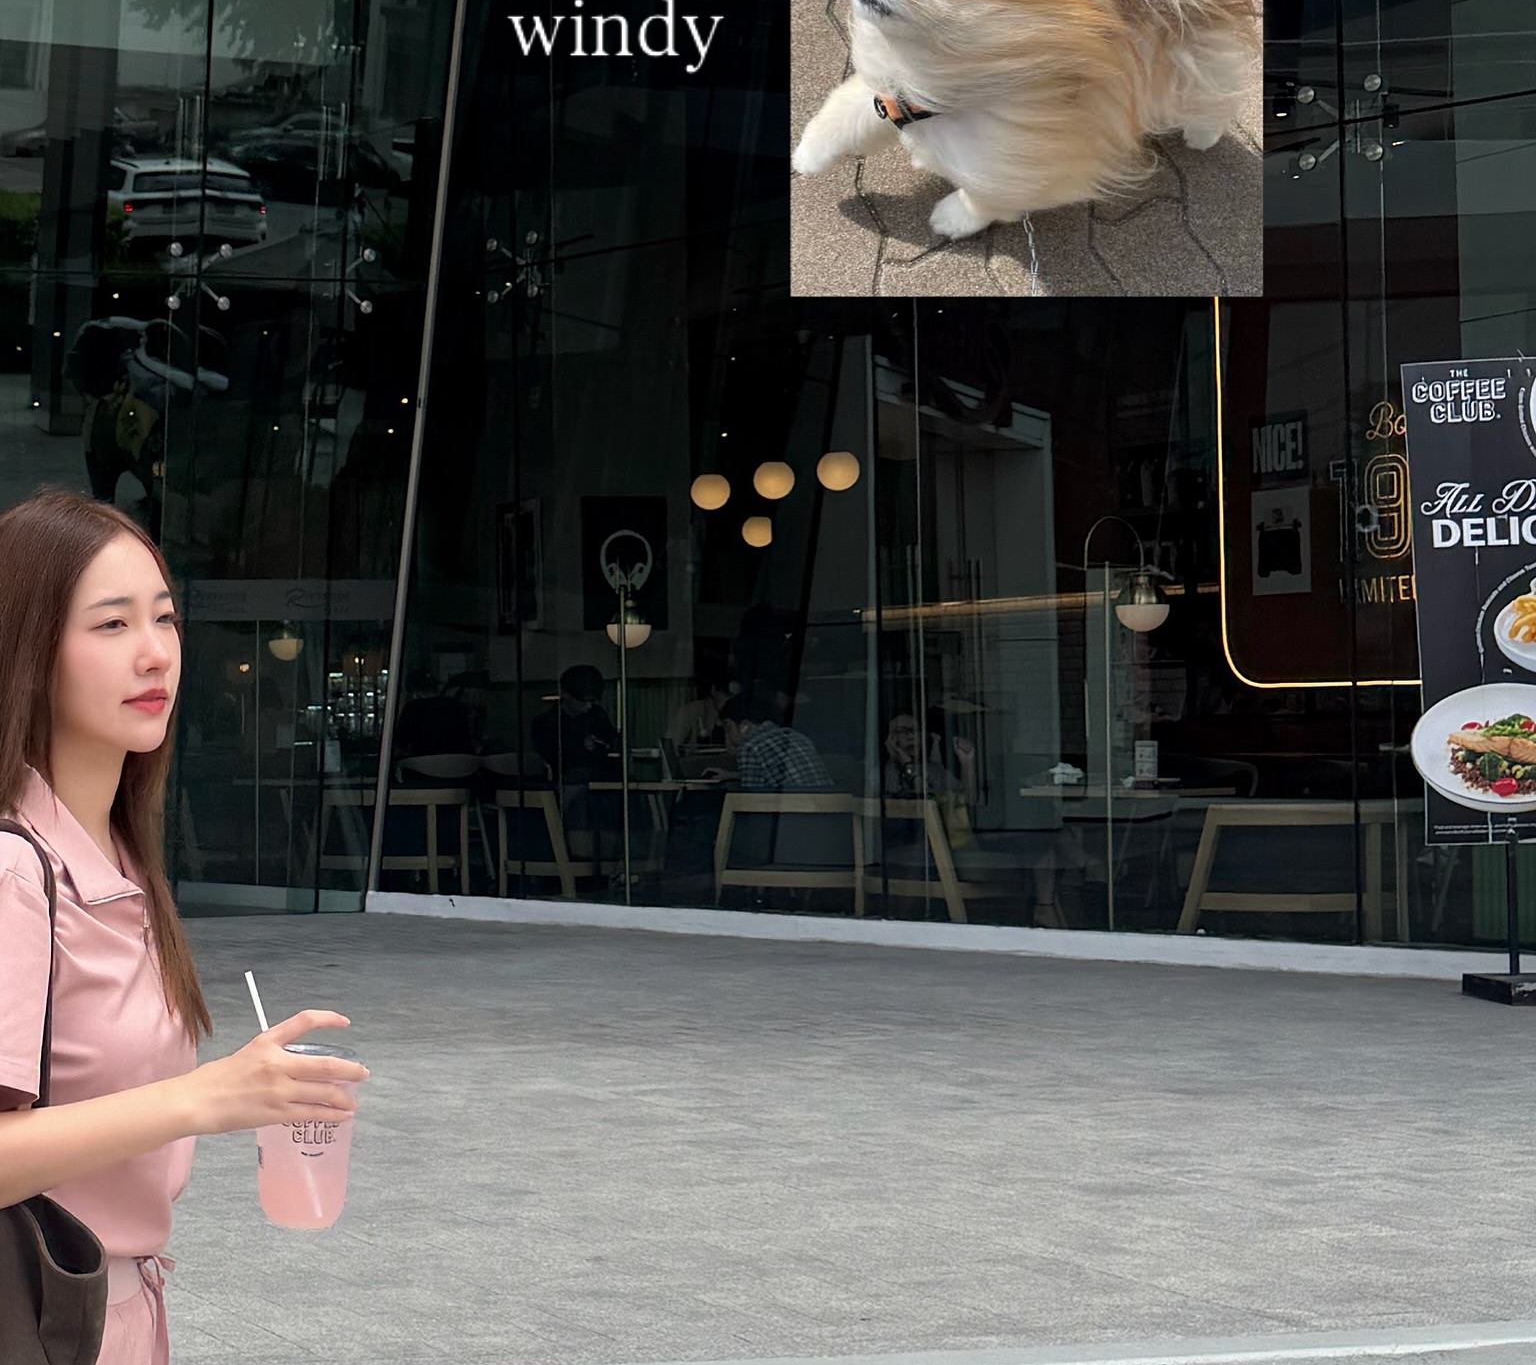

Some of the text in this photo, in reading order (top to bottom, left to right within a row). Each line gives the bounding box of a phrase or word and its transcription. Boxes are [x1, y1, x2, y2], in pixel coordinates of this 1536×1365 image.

[1449, 369, 1469, 378] THE
[1412, 378, 1506, 403] COFFEE
[1252, 421, 1304, 473] NICE!
